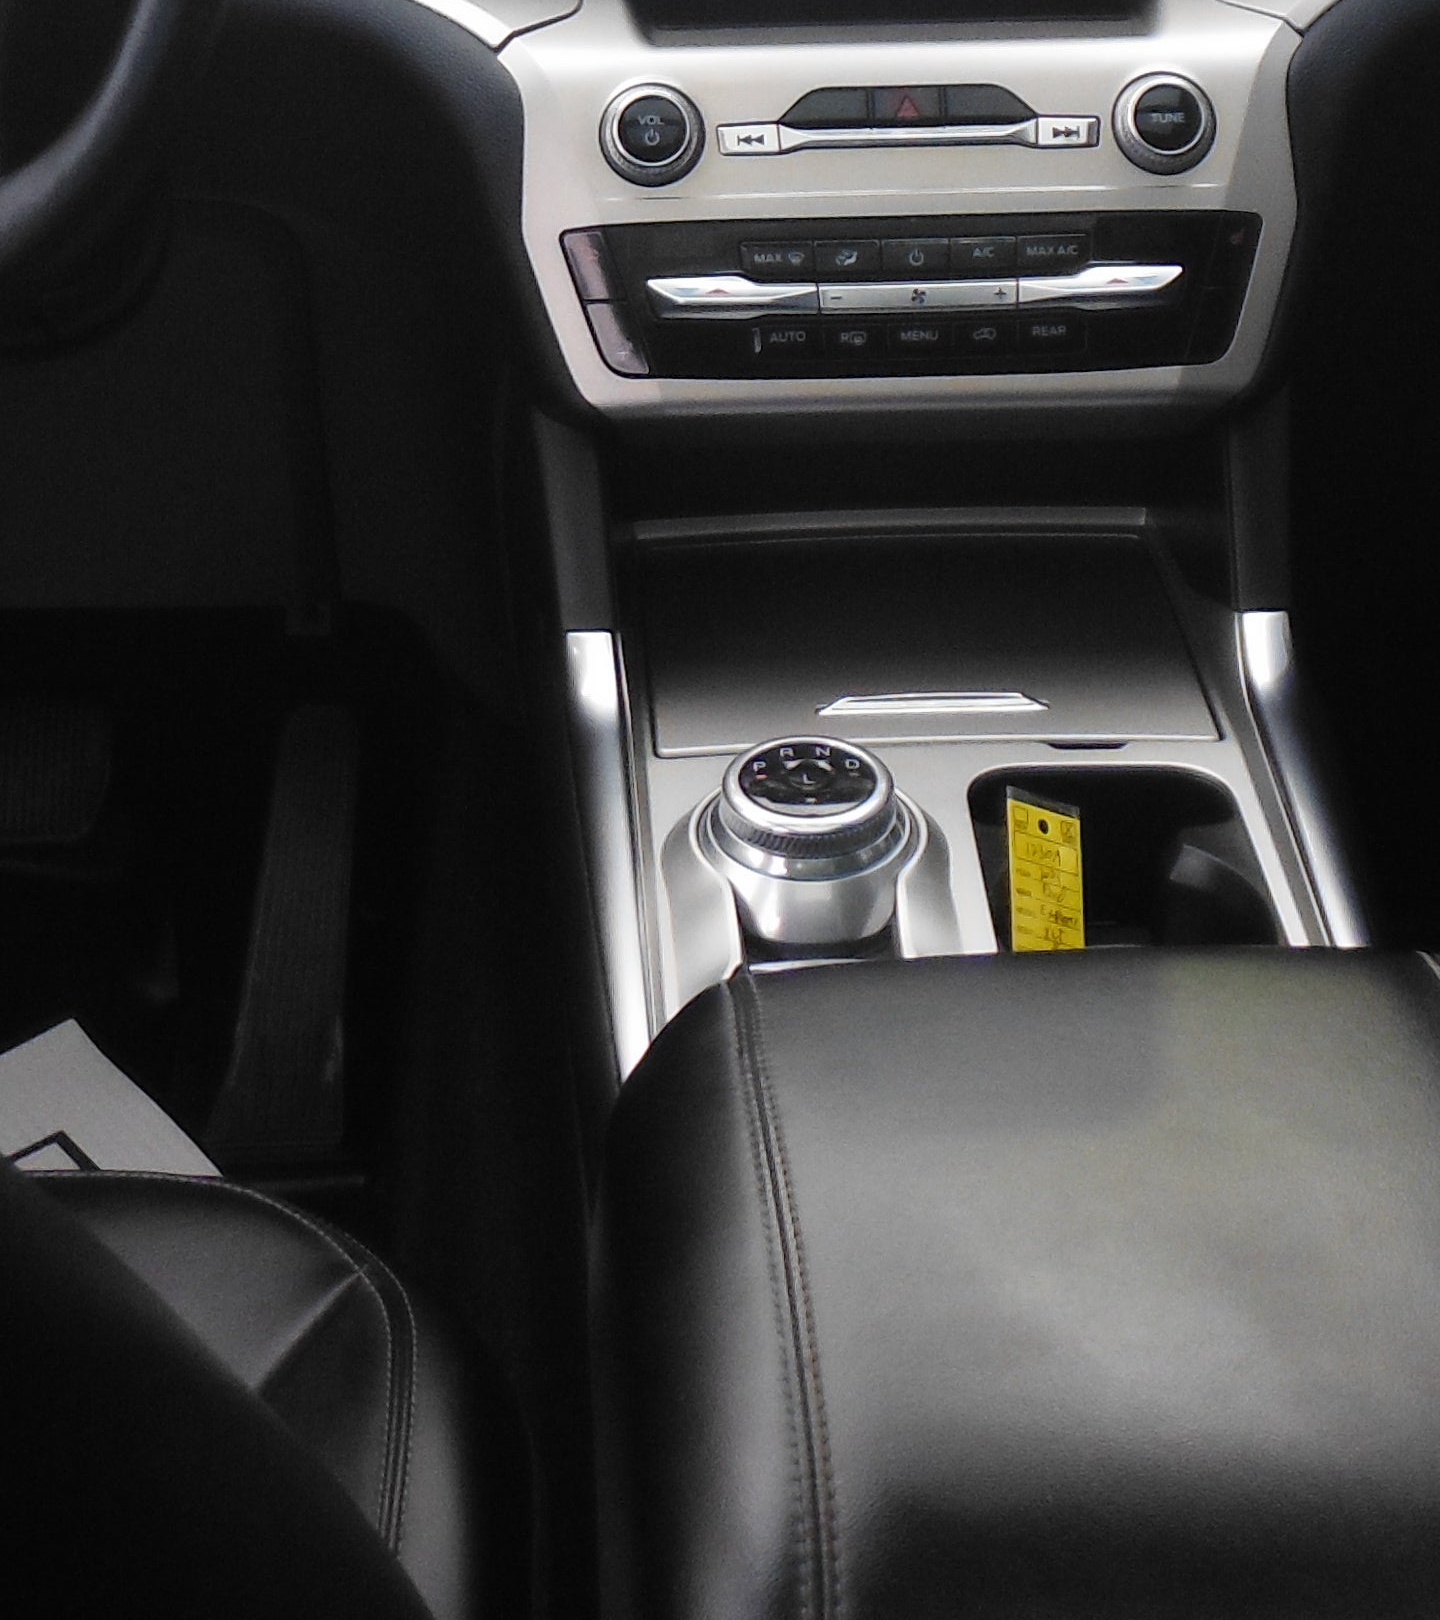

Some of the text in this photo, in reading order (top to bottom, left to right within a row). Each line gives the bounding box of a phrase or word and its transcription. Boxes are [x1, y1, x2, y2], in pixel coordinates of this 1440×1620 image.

[637, 115, 665, 125] VOL
[1150, 111, 1186, 124] TUNE
[971, 246, 995, 258] A/C
[1026, 244, 1079, 257] MAX A/C
[753, 252, 783, 264] MAX
[769, 331, 807, 343] AUTO
[900, 329, 939, 341] MENU
[1032, 325, 1067, 337] REAR
[779, 747, 795, 757] R
[815, 746, 831, 758] N
[753, 761, 767, 772] P
[845, 759, 860, 770] D
[803, 774, 816, 784] L
